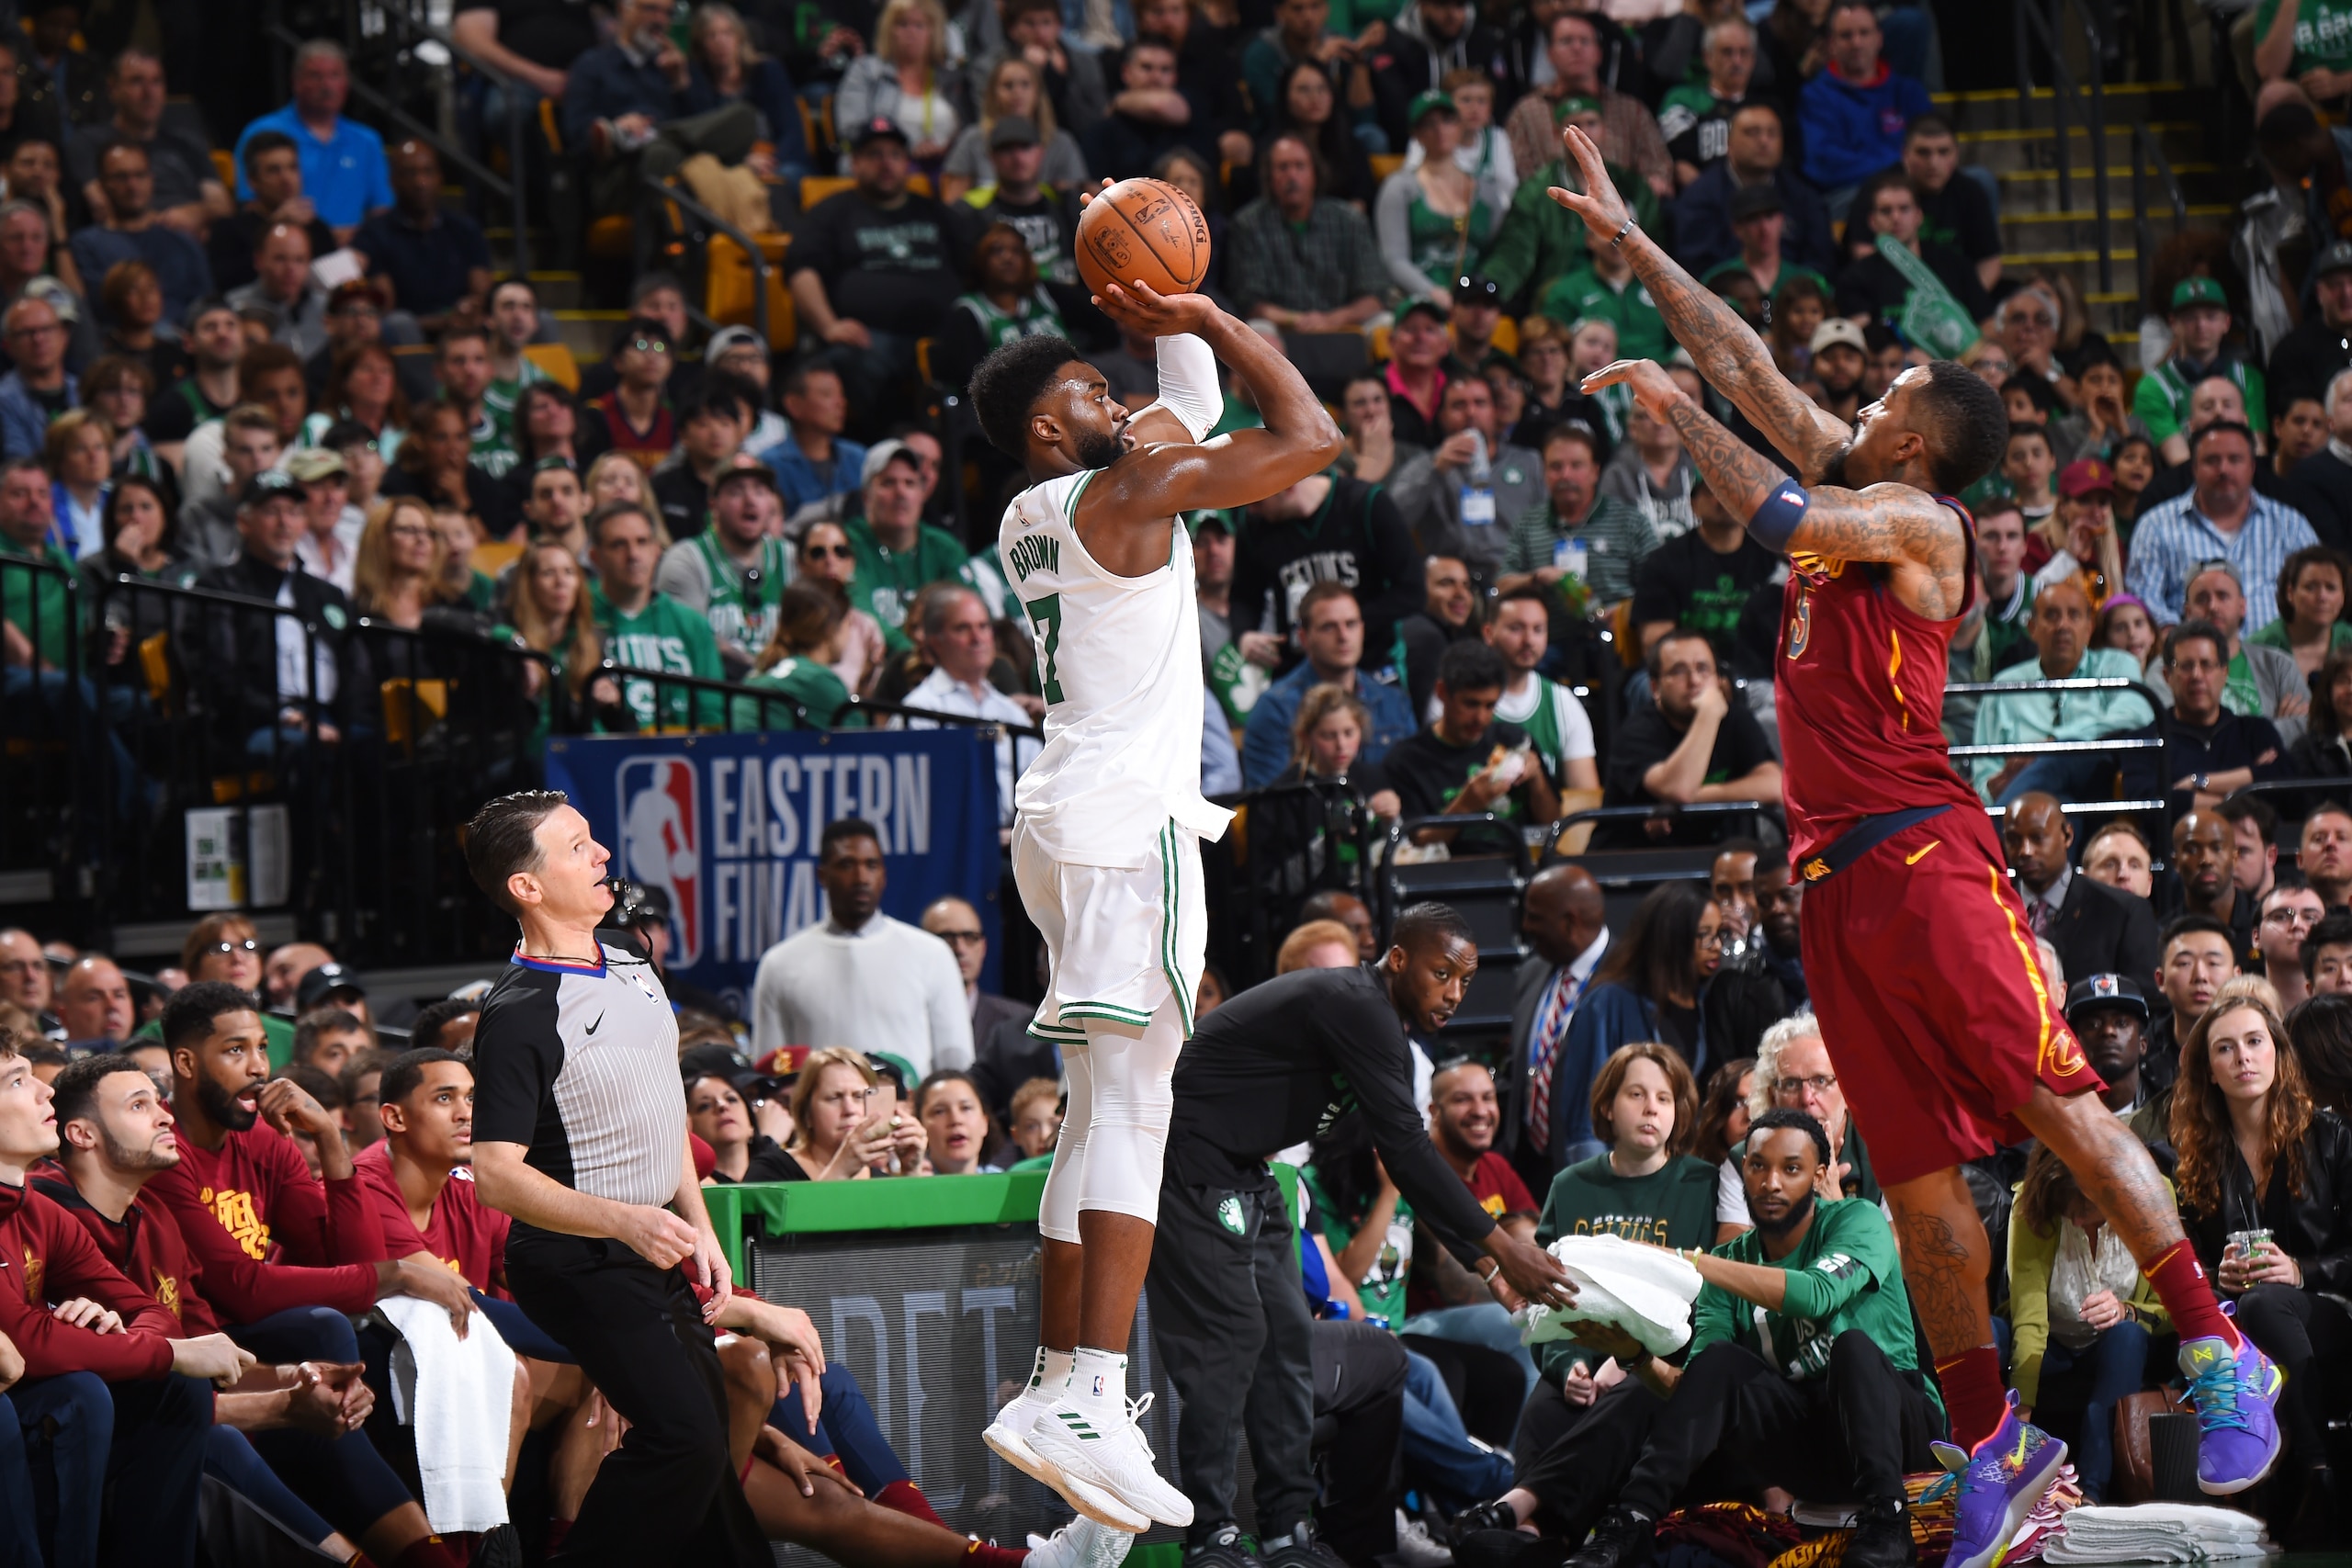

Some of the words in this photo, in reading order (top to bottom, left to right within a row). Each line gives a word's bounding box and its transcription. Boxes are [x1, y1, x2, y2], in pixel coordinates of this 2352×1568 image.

[1155, 178, 1207, 243] ALDING
[1009, 534, 1059, 583] BROWN
[1025, 592, 1066, 706] 7
[710, 753, 932, 859] EASTERN
[713, 860, 832, 964] FINA
